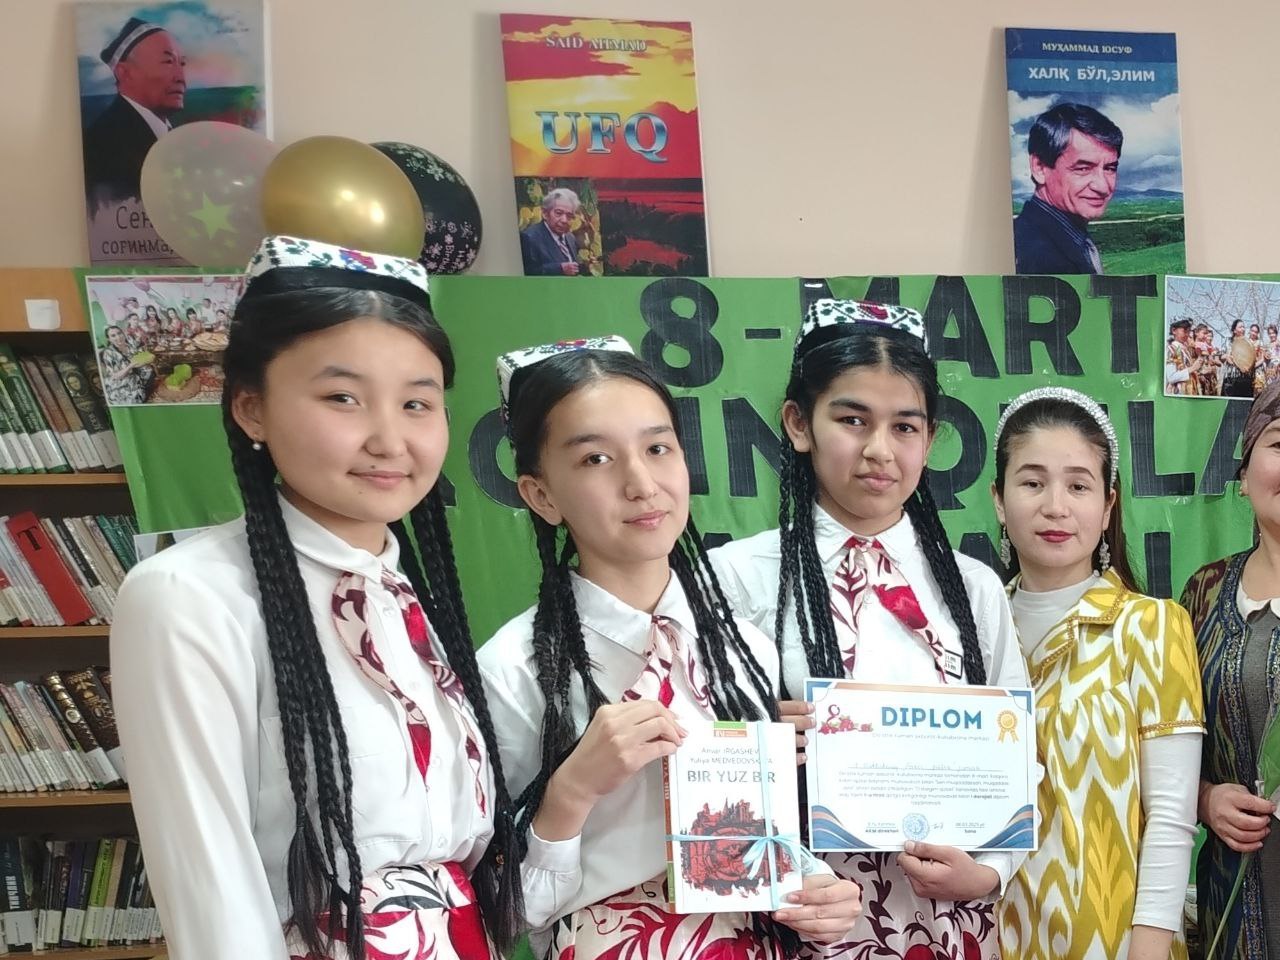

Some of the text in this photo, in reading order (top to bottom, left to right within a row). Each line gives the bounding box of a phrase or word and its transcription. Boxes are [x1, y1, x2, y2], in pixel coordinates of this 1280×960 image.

[546, 37, 583, 48] SAID
[1102, 45, 1133, 54] ЮСУФ
[1028, 67, 1070, 81] ХАЛҚ
[535, 111, 668, 163] UFQ
[881, 706, 982, 730] DIPLOM
[687, 770, 776, 783] BIR YUZ BR
